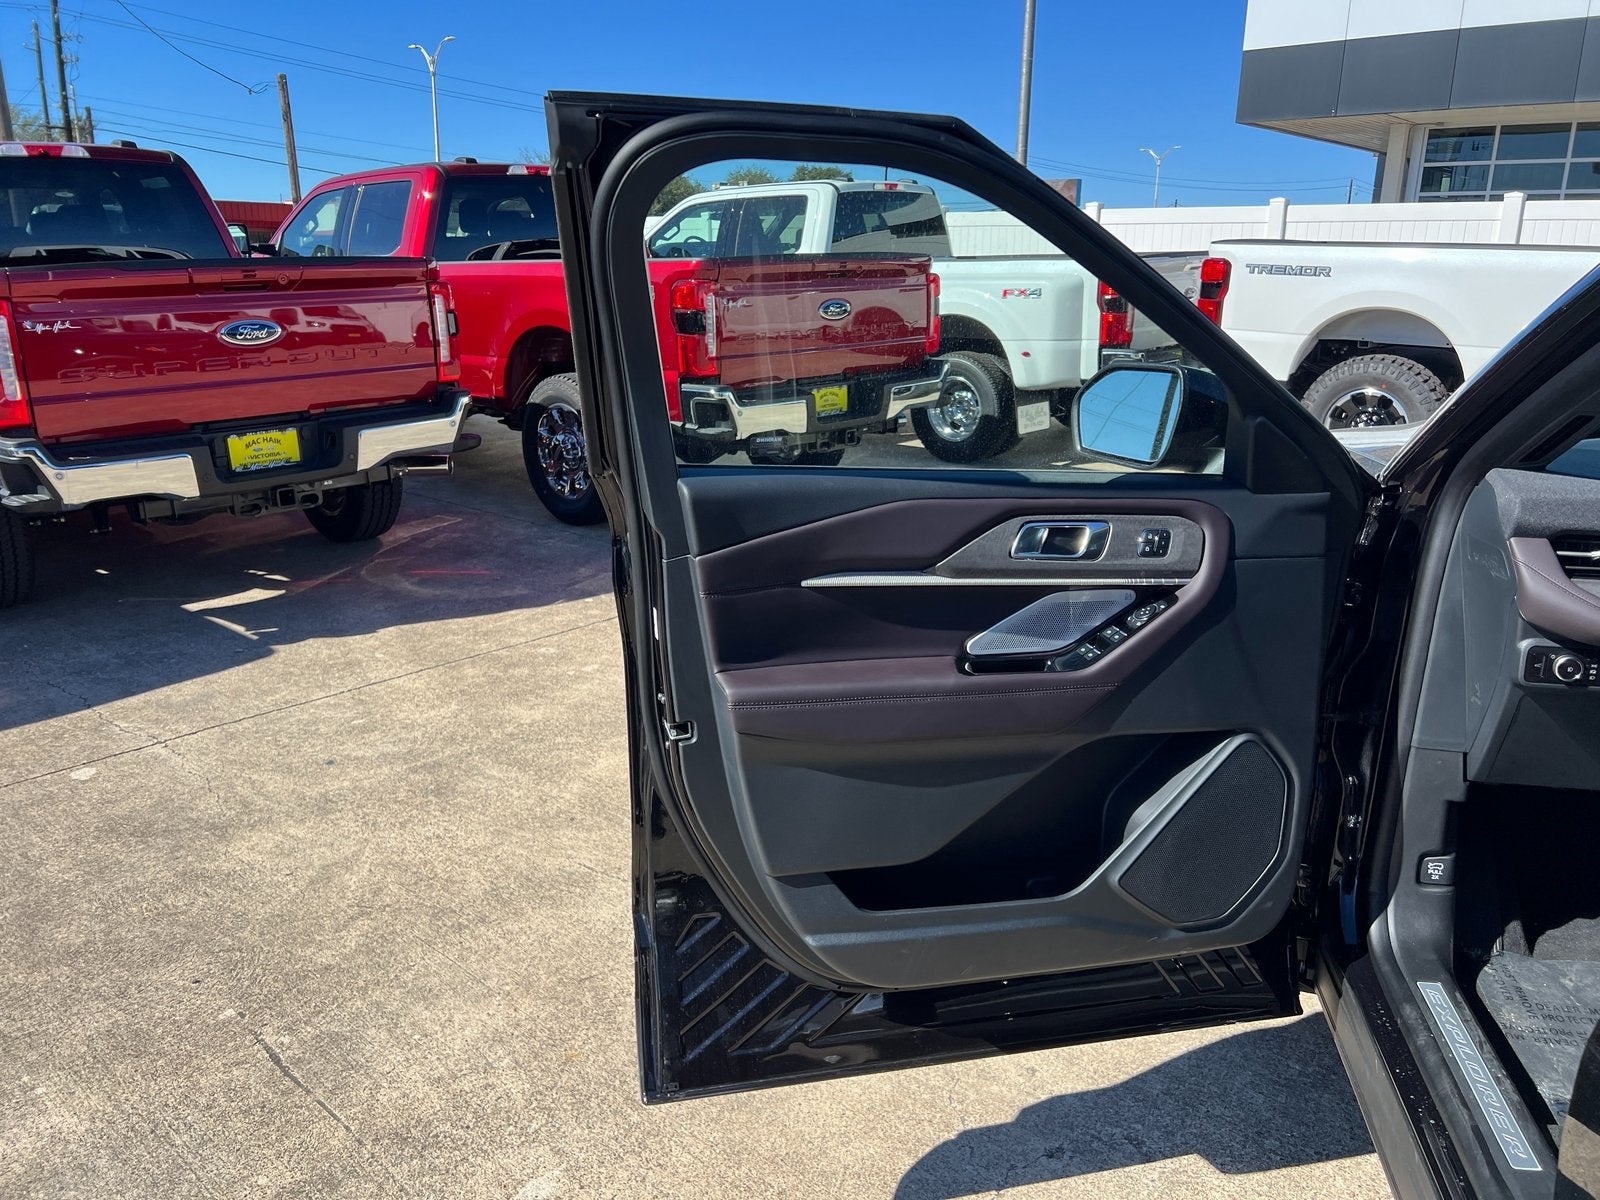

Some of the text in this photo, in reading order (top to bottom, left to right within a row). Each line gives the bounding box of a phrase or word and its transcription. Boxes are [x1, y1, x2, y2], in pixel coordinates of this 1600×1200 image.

[1246, 263, 1332, 277] TREMOR
[1001, 288, 1042, 299] FX4
[245, 437, 282, 449] MAC HAIK
[249, 451, 281, 460] VICTORIA
[1513, 985, 1539, 1020] REMOVE
[1426, 989, 1528, 1159] EXPLORER
